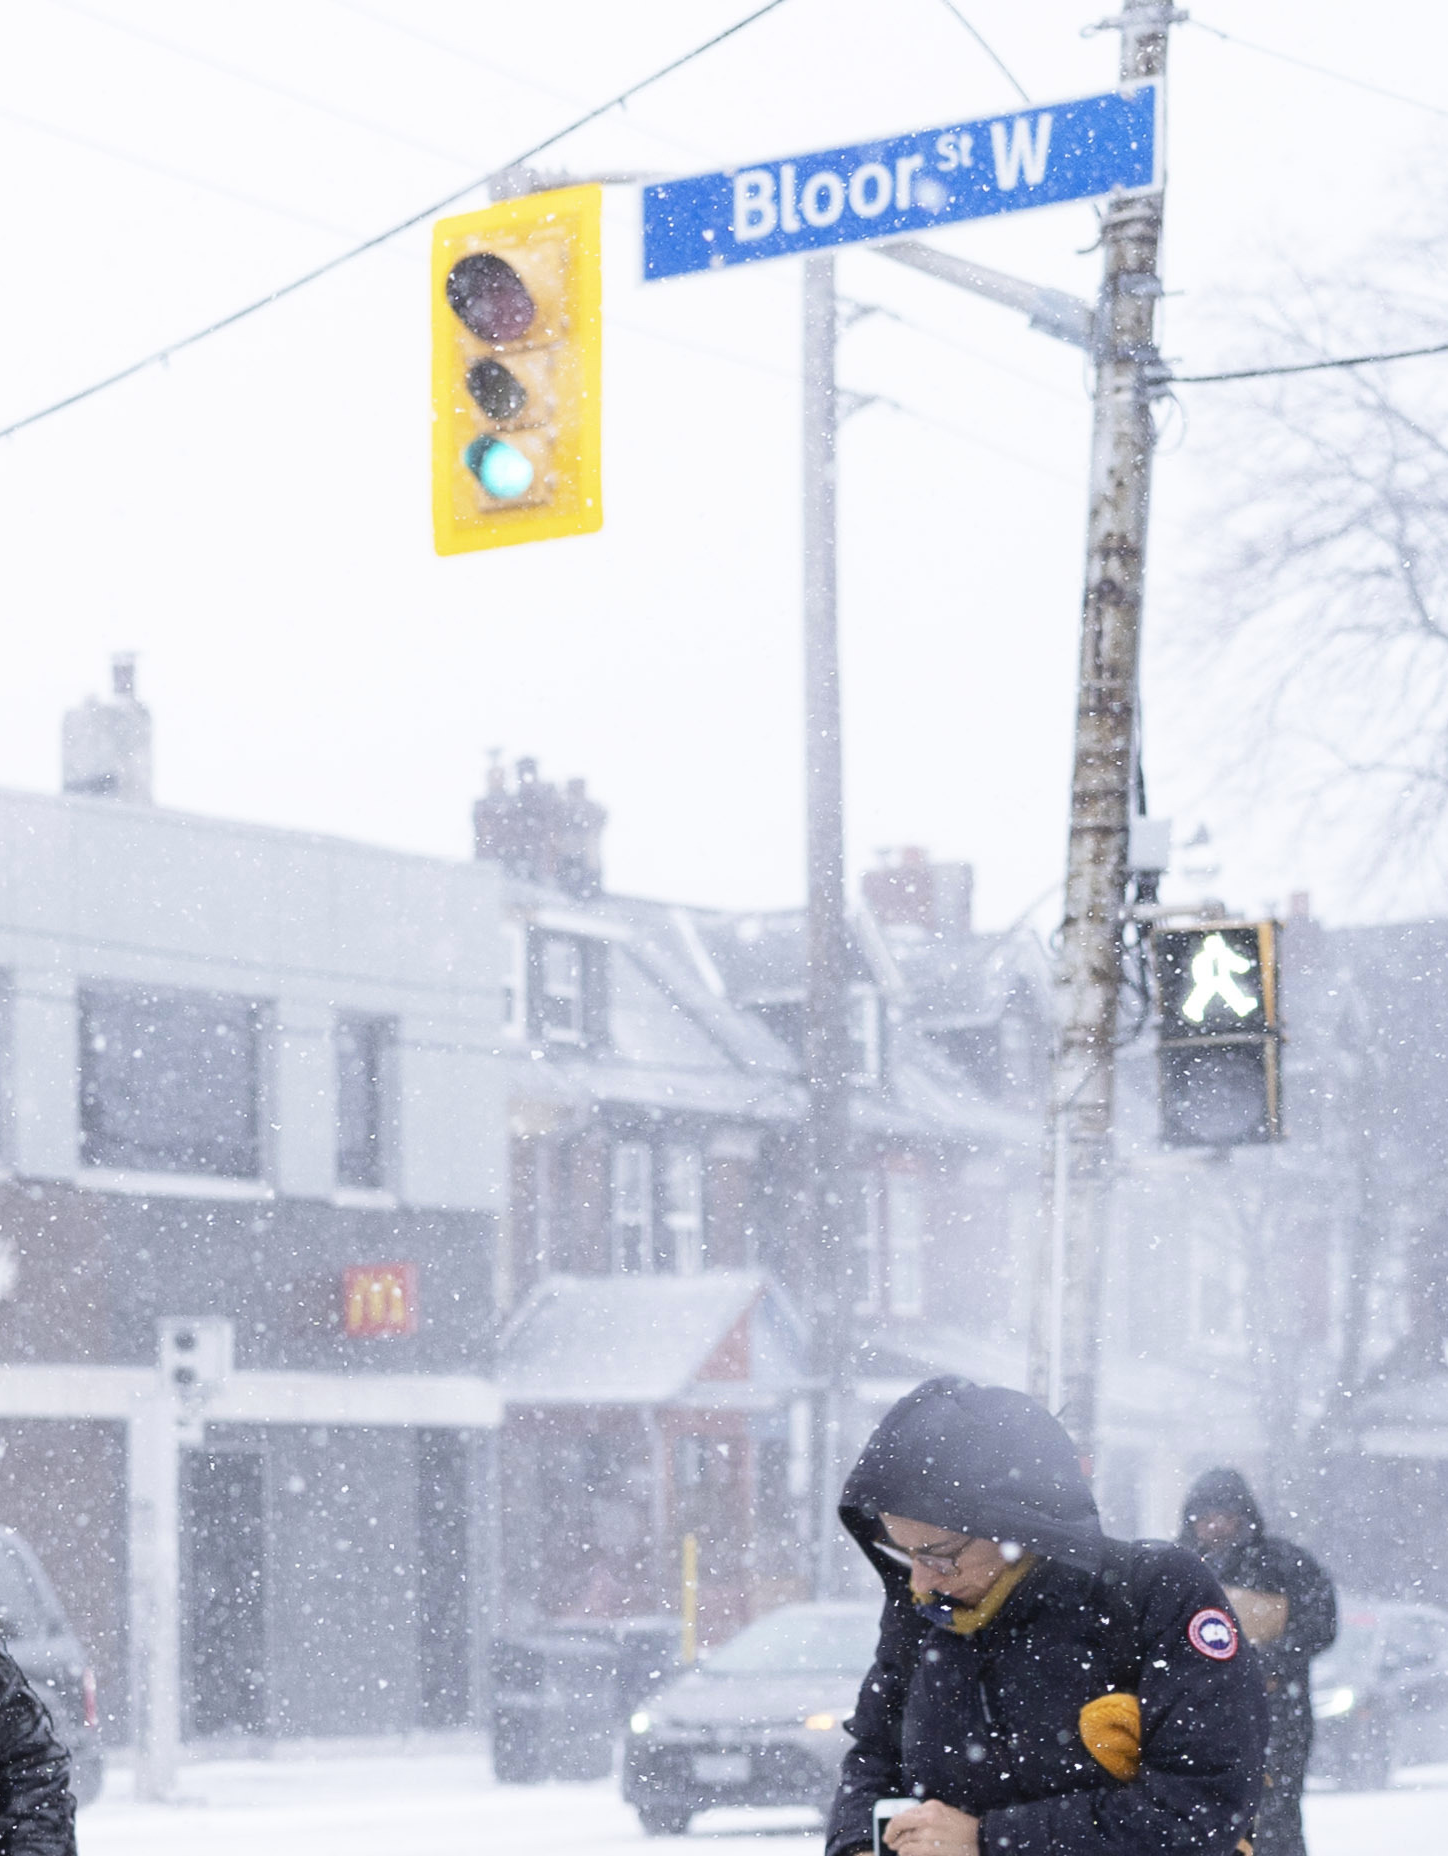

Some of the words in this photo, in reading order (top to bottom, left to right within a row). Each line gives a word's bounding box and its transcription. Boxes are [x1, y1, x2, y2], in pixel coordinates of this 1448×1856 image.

[733, 154, 925, 243] Bloor
[936, 131, 974, 172] St
[989, 112, 1053, 191] W
